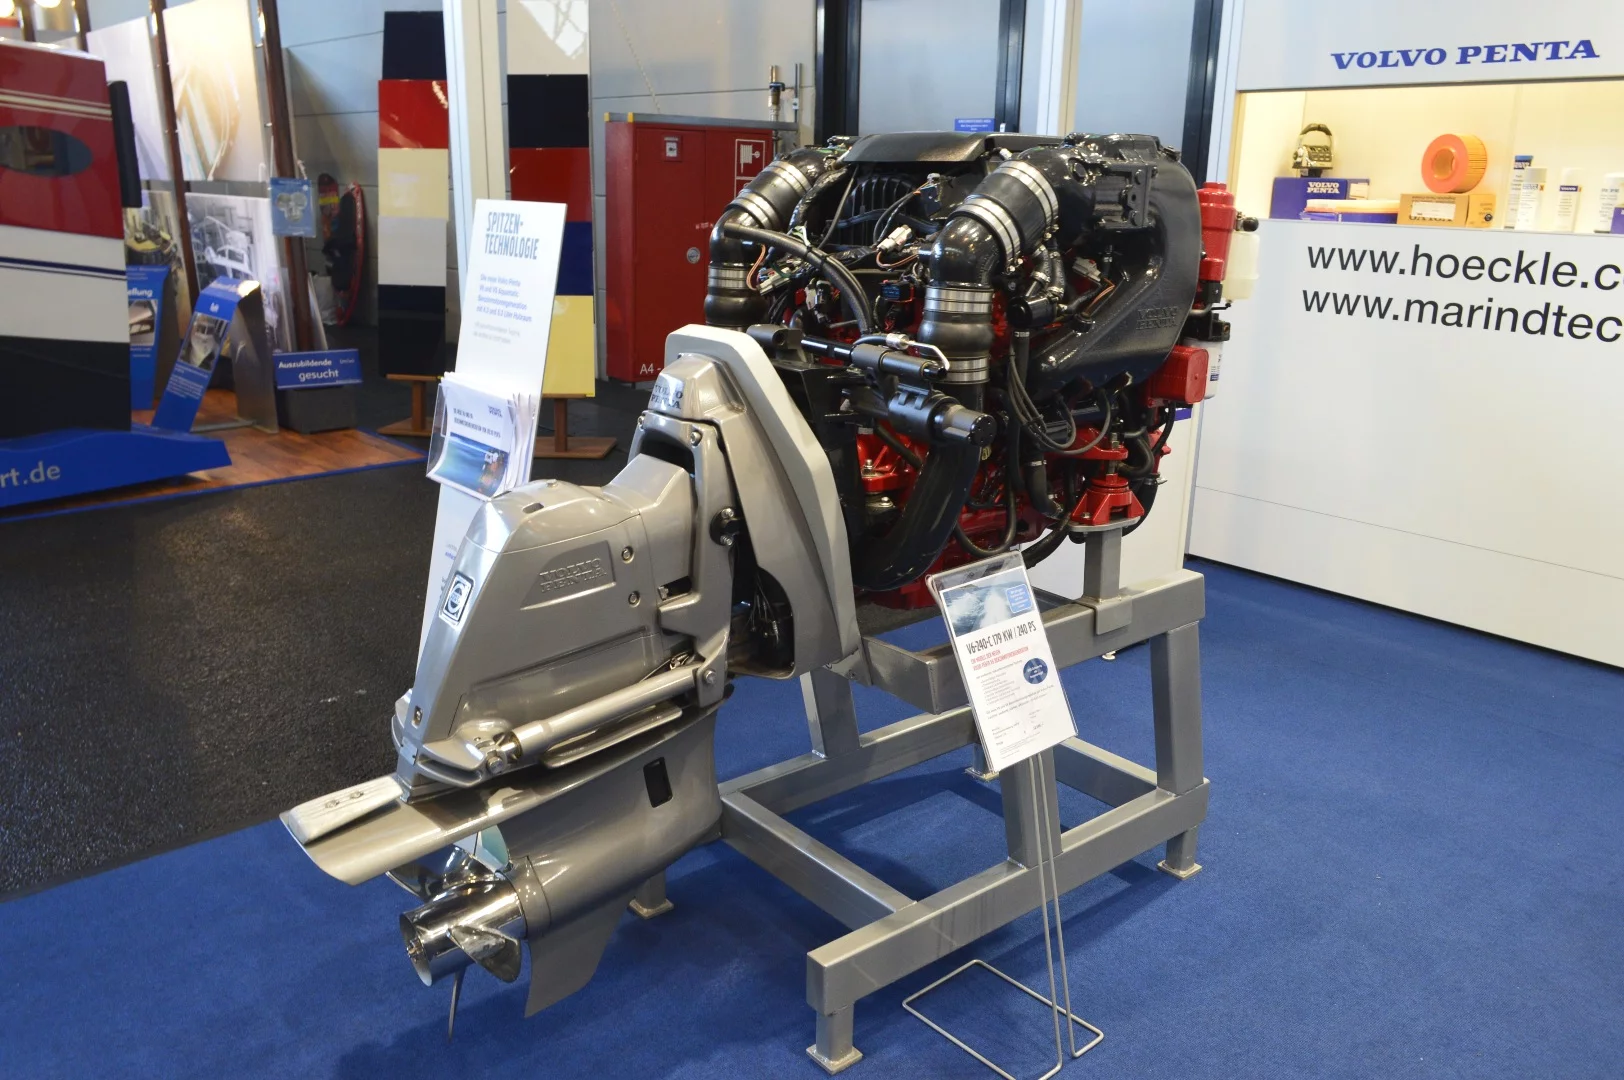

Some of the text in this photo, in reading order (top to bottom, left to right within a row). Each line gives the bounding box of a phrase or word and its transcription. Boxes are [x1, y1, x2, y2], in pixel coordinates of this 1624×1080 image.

[1331, 39, 1600, 70] VOLVO PENTA
[487, 211, 524, 234] SPITZEN-
[484, 233, 540, 260] TECHNOLOGIE
[1307, 244, 1624, 291] www.hoeckle.c
[1302, 289, 1623, 343] www.marindtec
[278, 359, 332, 369] Auszubildende
[298, 368, 339, 382] gesucht
[639, 363, 654, 375] A4
[650, 394, 682, 410] PENA
[655, 384, 684, 399] VOLO
[539, 558, 601, 581] VOLVO
[540, 567, 608, 593] PENTA
[965, 635, 993, 655] V6-240-C
[992, 632, 1003, 645] 179
[1002, 628, 1014, 642] KW
[1017, 623, 1029, 637] 240
[1027, 620, 1037, 632] PS
